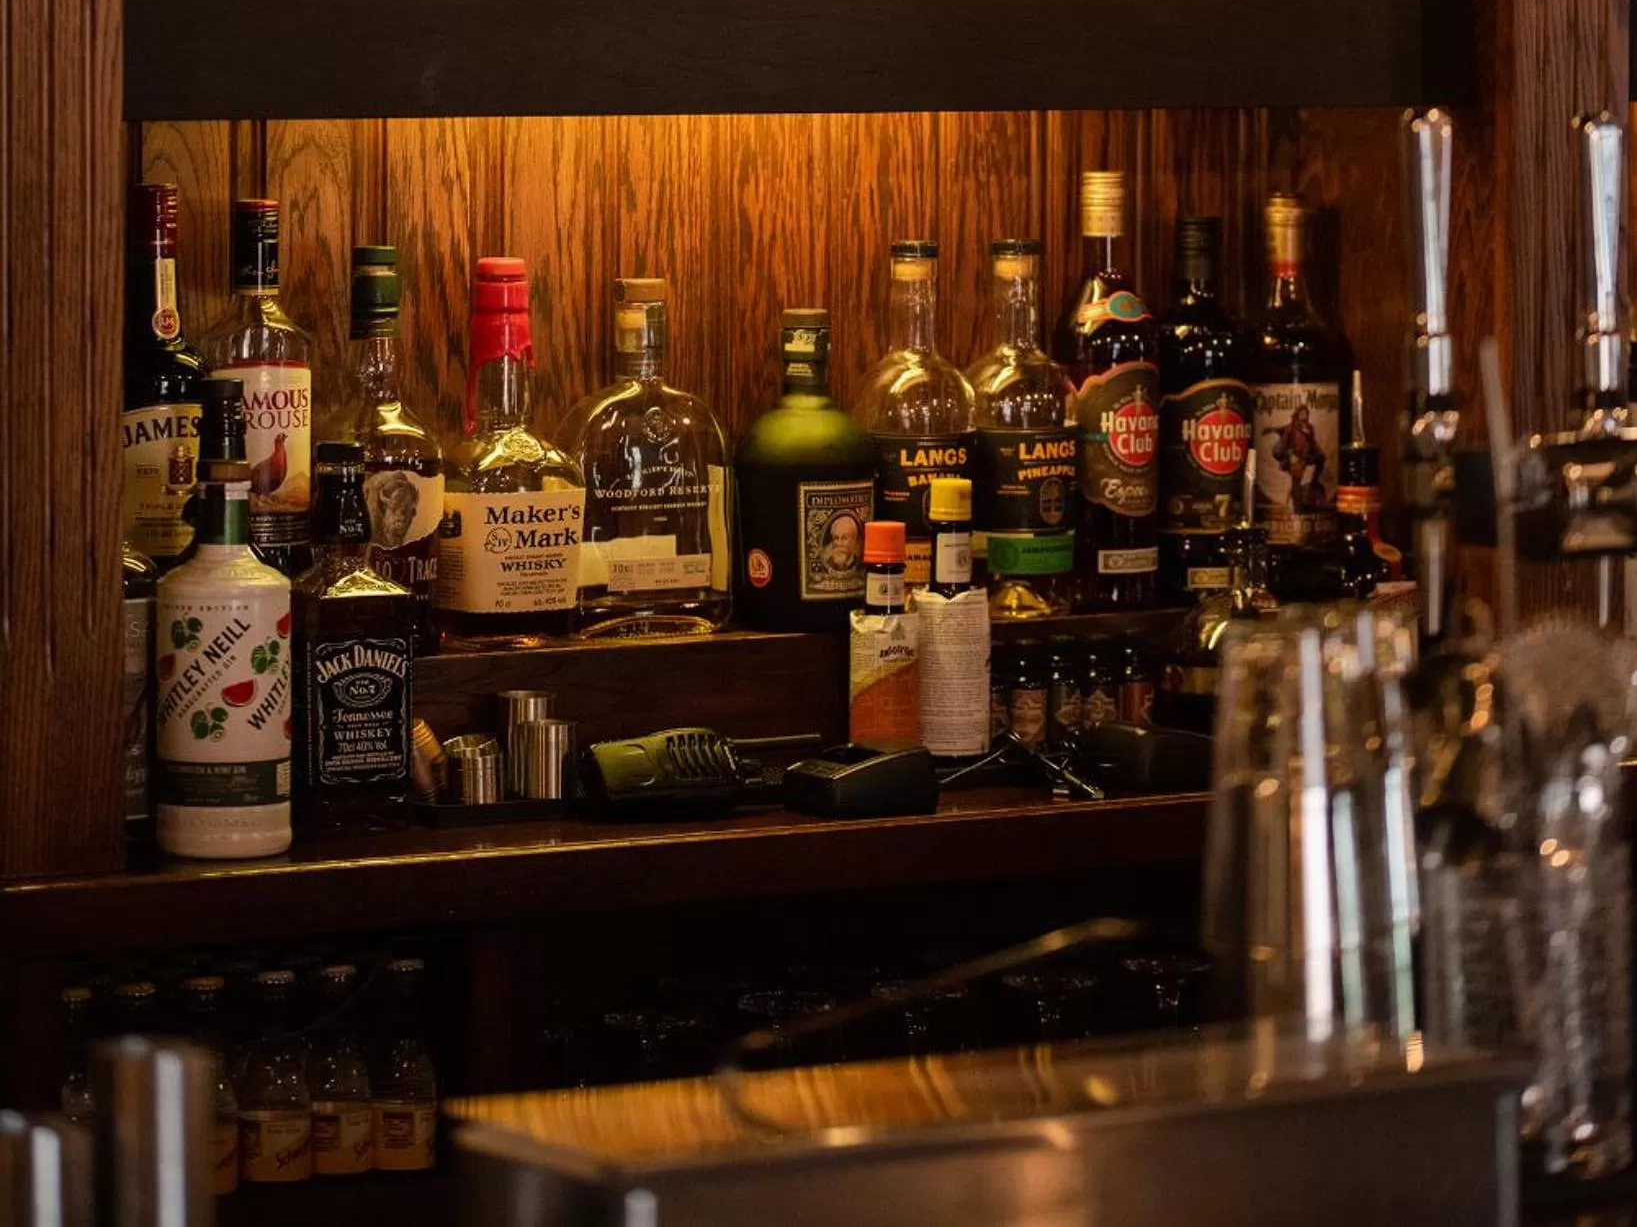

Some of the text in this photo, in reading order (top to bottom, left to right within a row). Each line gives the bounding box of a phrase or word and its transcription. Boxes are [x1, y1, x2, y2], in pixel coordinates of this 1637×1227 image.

[1019, 440, 1076, 460] LANGS
[1116, 433, 1153, 455] Club
[1200, 442, 1243, 463] Club
[900, 447, 967, 467] LANGS
[483, 505, 581, 525] Maker's
[1214, 493, 1232, 517] 7
[513, 527, 579, 549] Mark
[500, 557, 568, 573] WHISKY
[202, 617, 251, 664] NEILL
[315, 643, 410, 684] JACK DANIEL'S
[332, 707, 395, 725] Tennessee
[333, 726, 393, 742] WHISKEY
